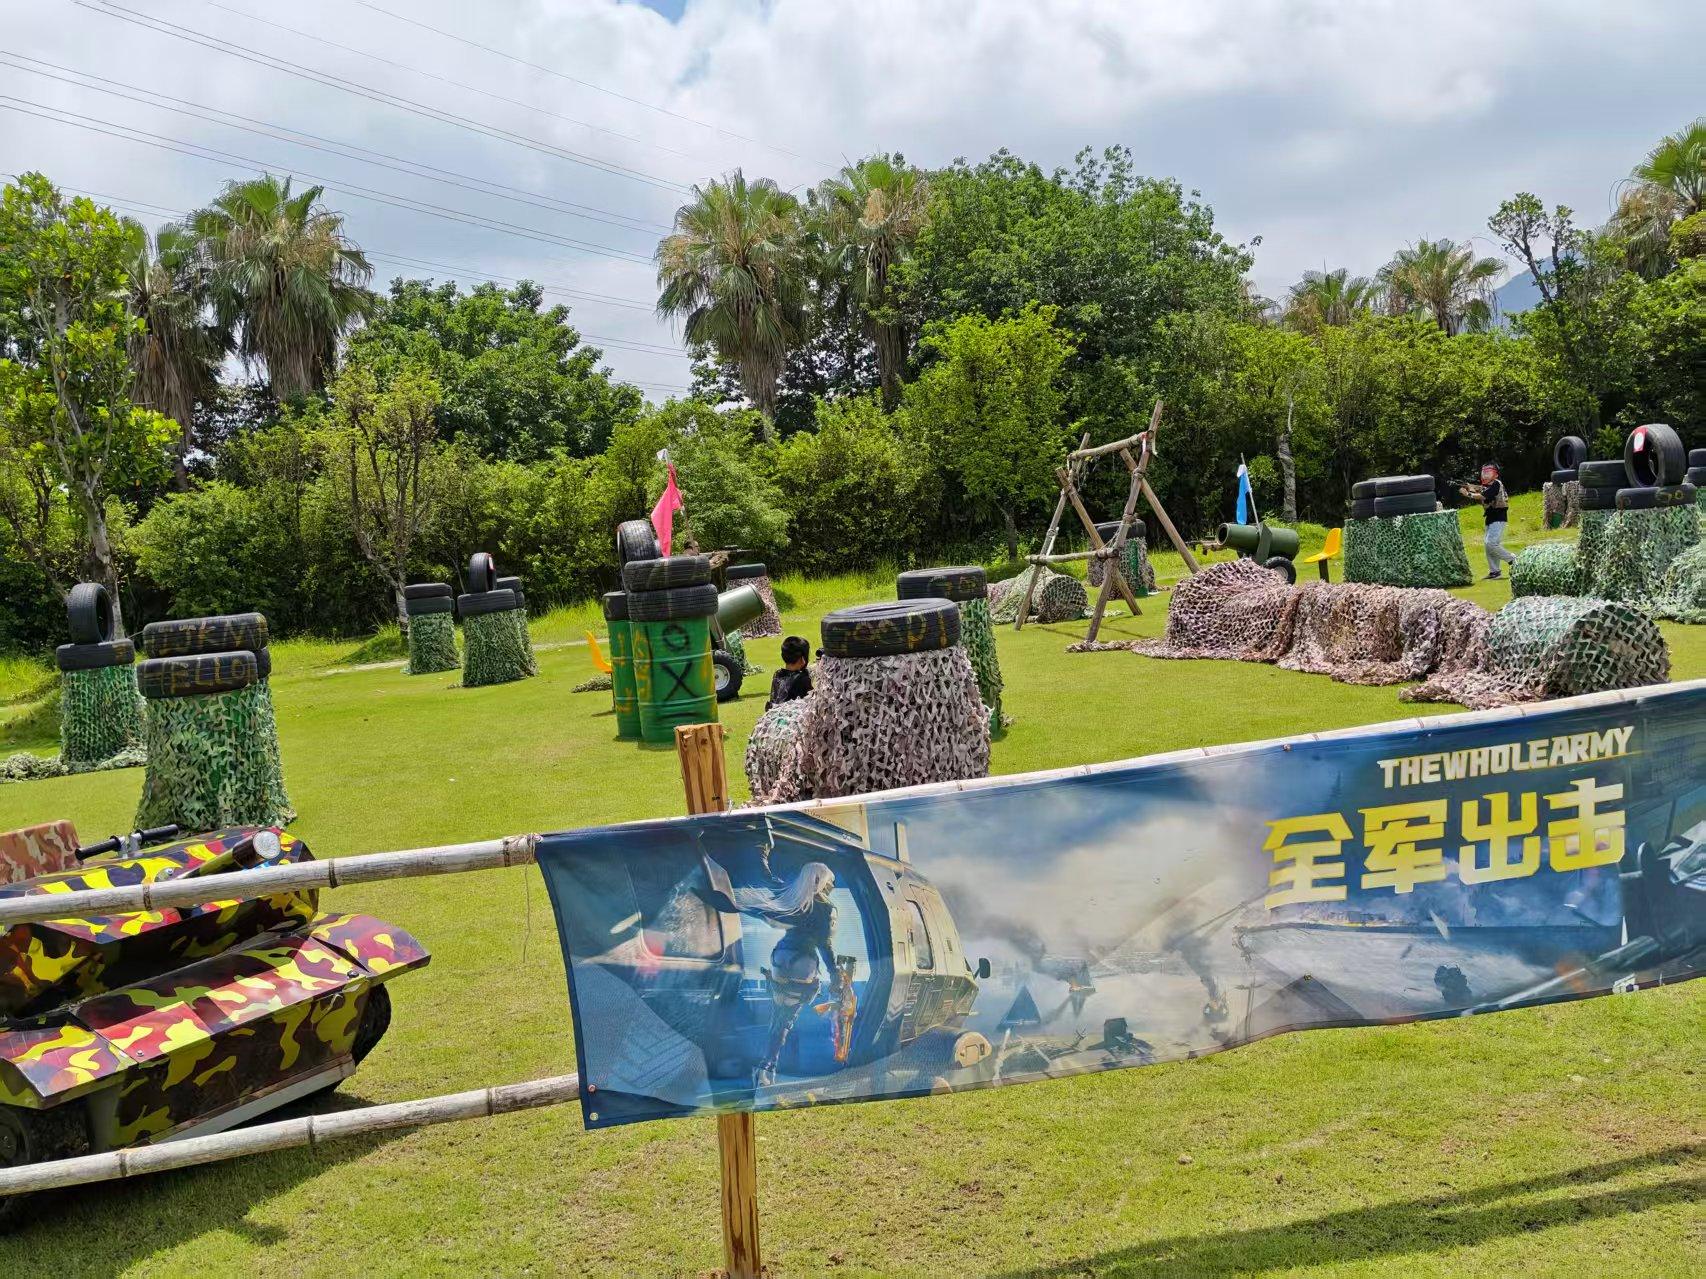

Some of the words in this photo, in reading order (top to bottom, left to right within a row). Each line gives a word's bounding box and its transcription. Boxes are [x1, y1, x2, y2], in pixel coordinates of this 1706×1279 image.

[1377, 726, 1634, 789] THEWHOLEARMY
[1262, 777, 1626, 911] 全军出击
